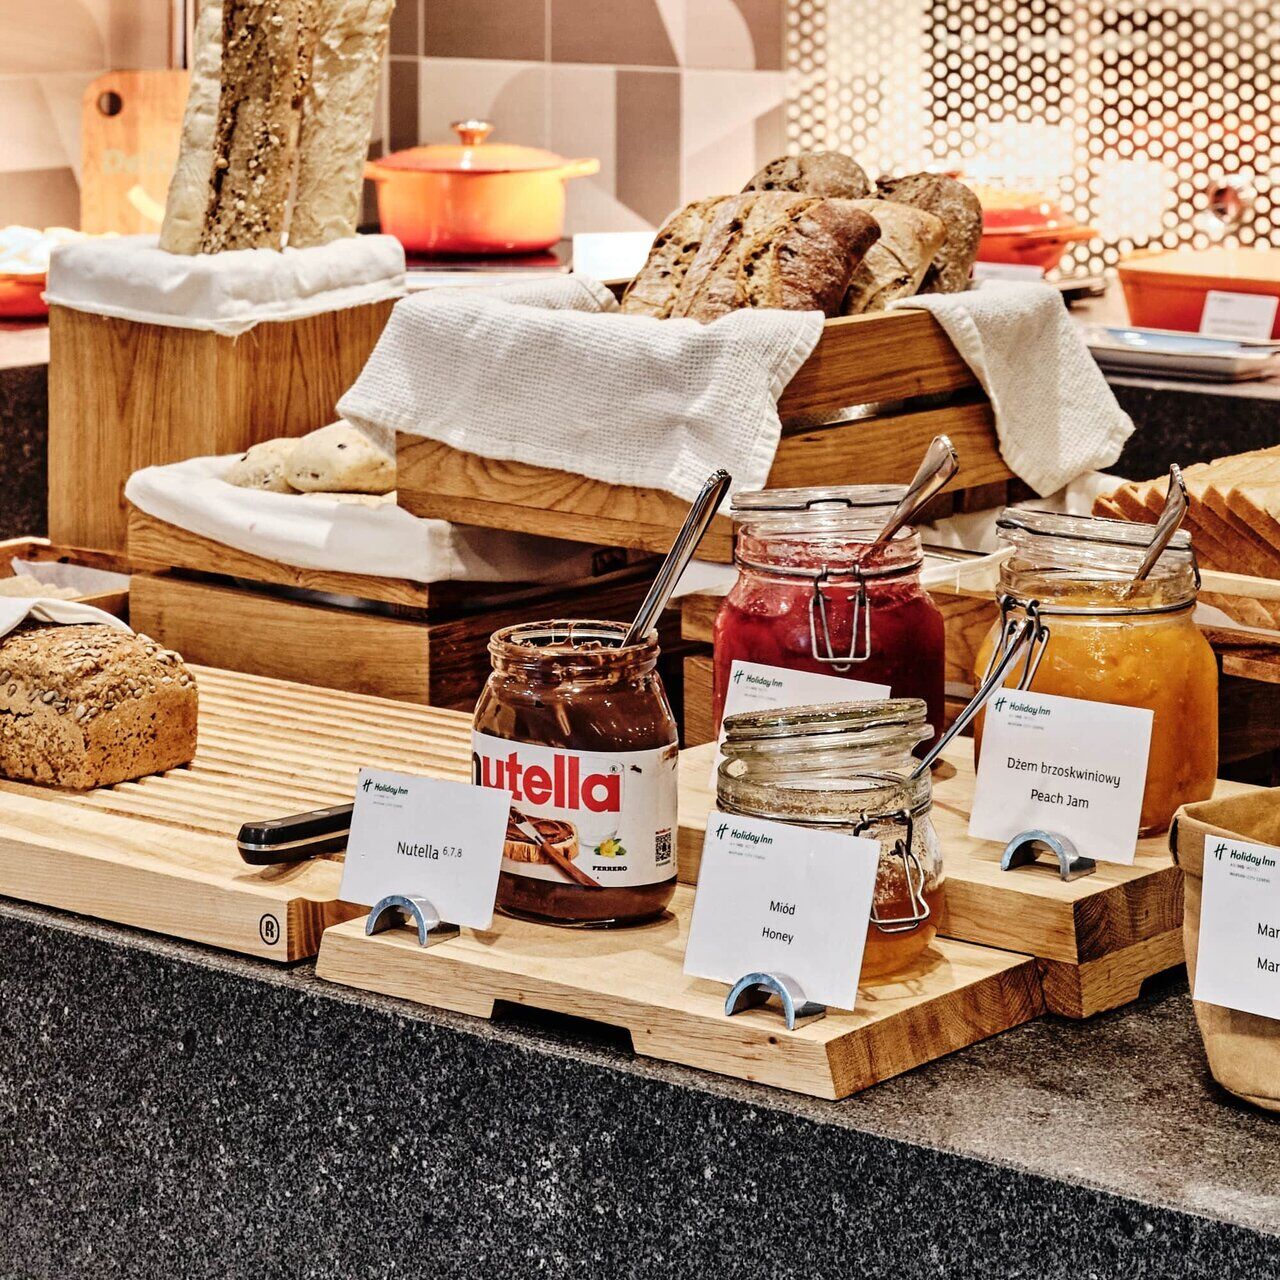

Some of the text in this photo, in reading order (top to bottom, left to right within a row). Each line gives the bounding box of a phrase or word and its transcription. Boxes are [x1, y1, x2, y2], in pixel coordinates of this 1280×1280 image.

[746, 674, 772, 688] Holiday
[772, 678, 783, 688] Inn
[1009, 701, 1039, 716] Holiday
[1038, 705, 1051, 716] Inn
[1007, 757, 1121, 788] Dżem brzoskwiniowy
[374, 782, 398, 796] Holiday
[398, 786, 409, 795] Inn
[1030, 789, 1090, 809] Peach Jam
[730, 828, 760, 845] Holiday
[760, 833, 773, 845] Inn
[396, 841, 439, 860] Nutella
[1229, 849, 1262, 868] Holiday
[1261, 855, 1276, 868] Inn
[769, 900, 796, 916] Miód
[761, 926, 794, 945] Honey
